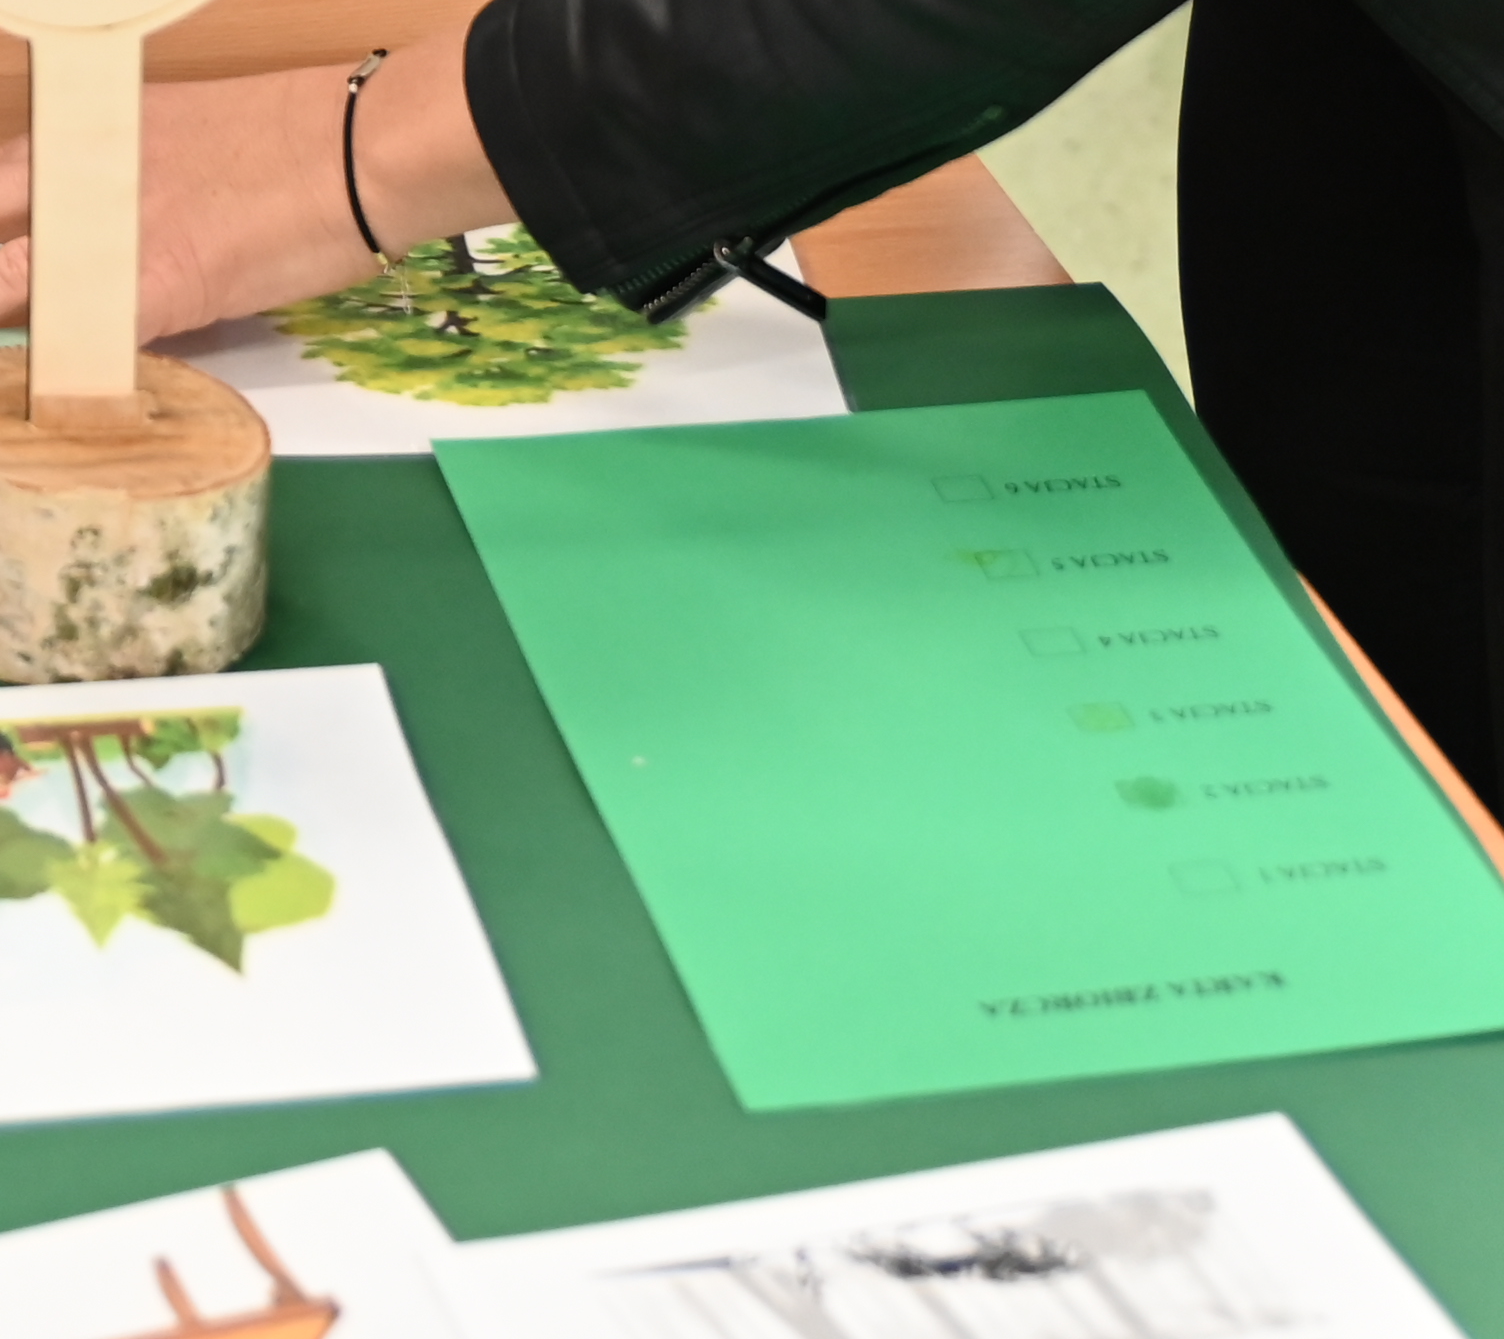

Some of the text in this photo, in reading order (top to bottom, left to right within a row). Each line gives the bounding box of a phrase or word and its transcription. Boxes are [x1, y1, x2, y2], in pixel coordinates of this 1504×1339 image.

[1004, 475, 1121, 494] STACJA 6
[1071, 549, 1169, 569] STACJA
[1118, 626, 1220, 646] STACJA
[1168, 700, 1274, 720] STACJA
